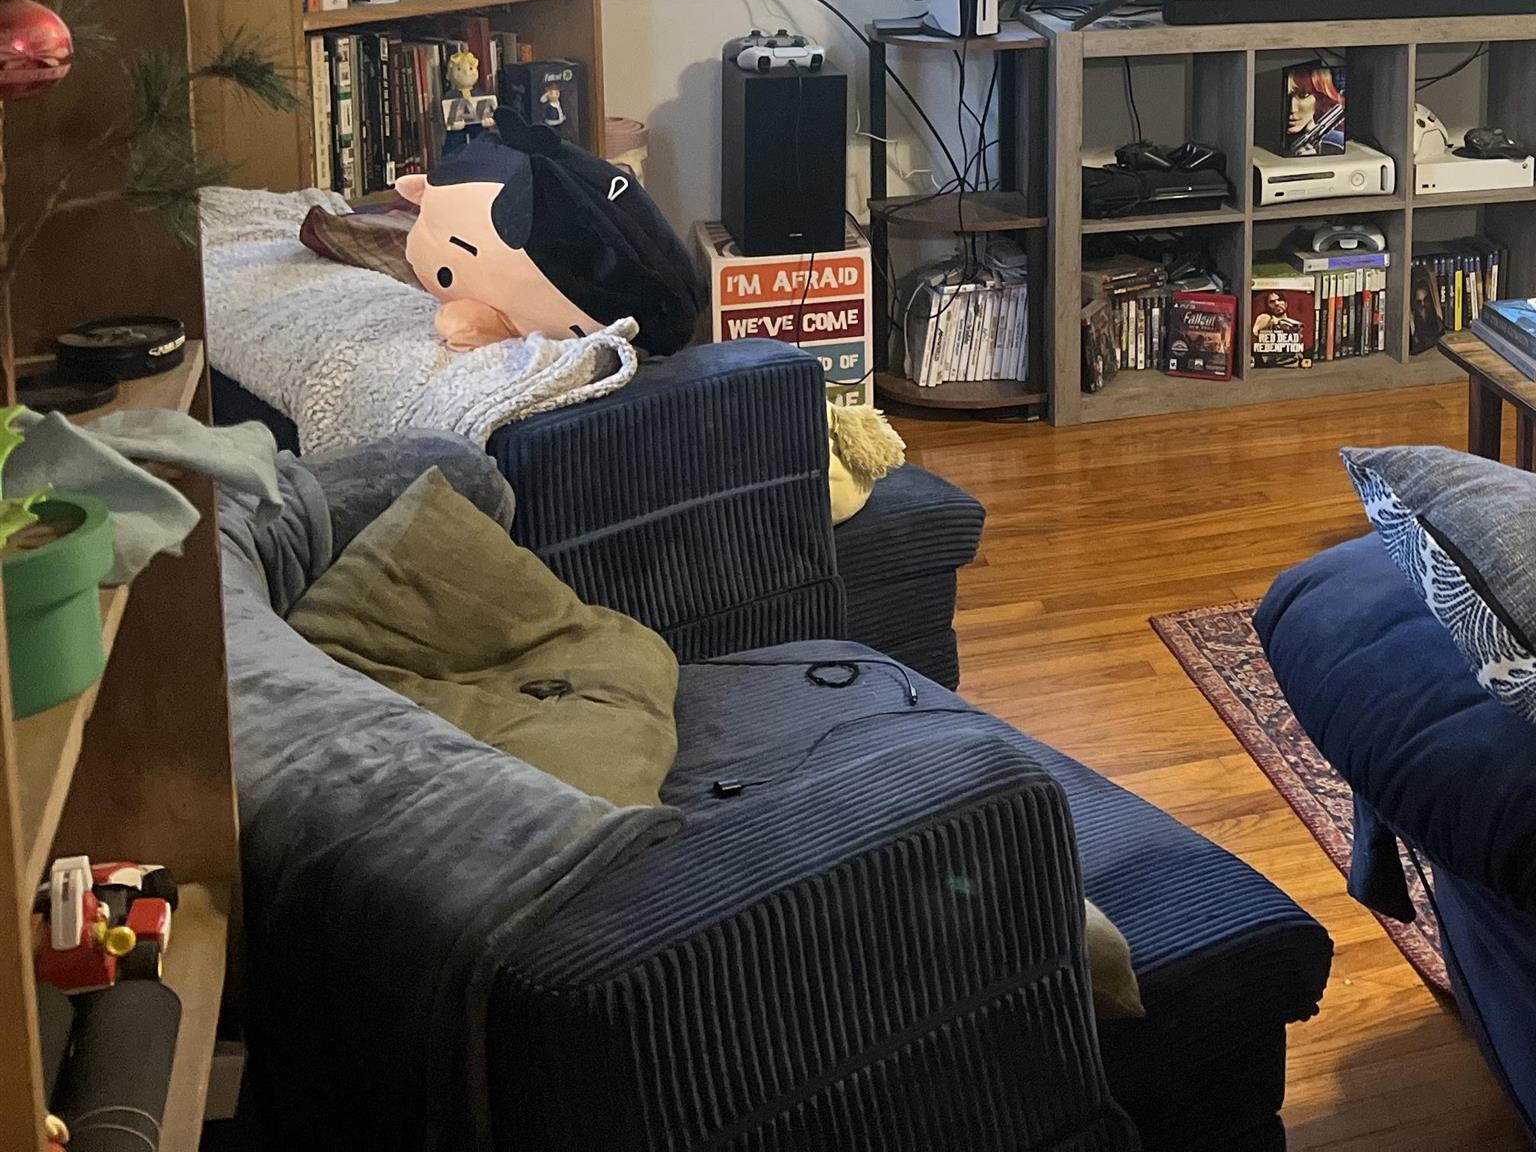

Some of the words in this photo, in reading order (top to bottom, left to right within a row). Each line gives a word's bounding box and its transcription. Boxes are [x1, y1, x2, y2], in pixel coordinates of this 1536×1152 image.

[726, 273, 762, 297] I'M
[772, 266, 859, 293] AFRAID
[727, 313, 795, 341] WE'VE
[802, 309, 859, 333] COME
[1183, 311, 1217, 327] Fallout
[1258, 333, 1276, 343] RED
[1276, 332, 1300, 343] DEAD
[1253, 342, 1304, 353] REDEMPTION
[840, 353, 859, 370] OF
